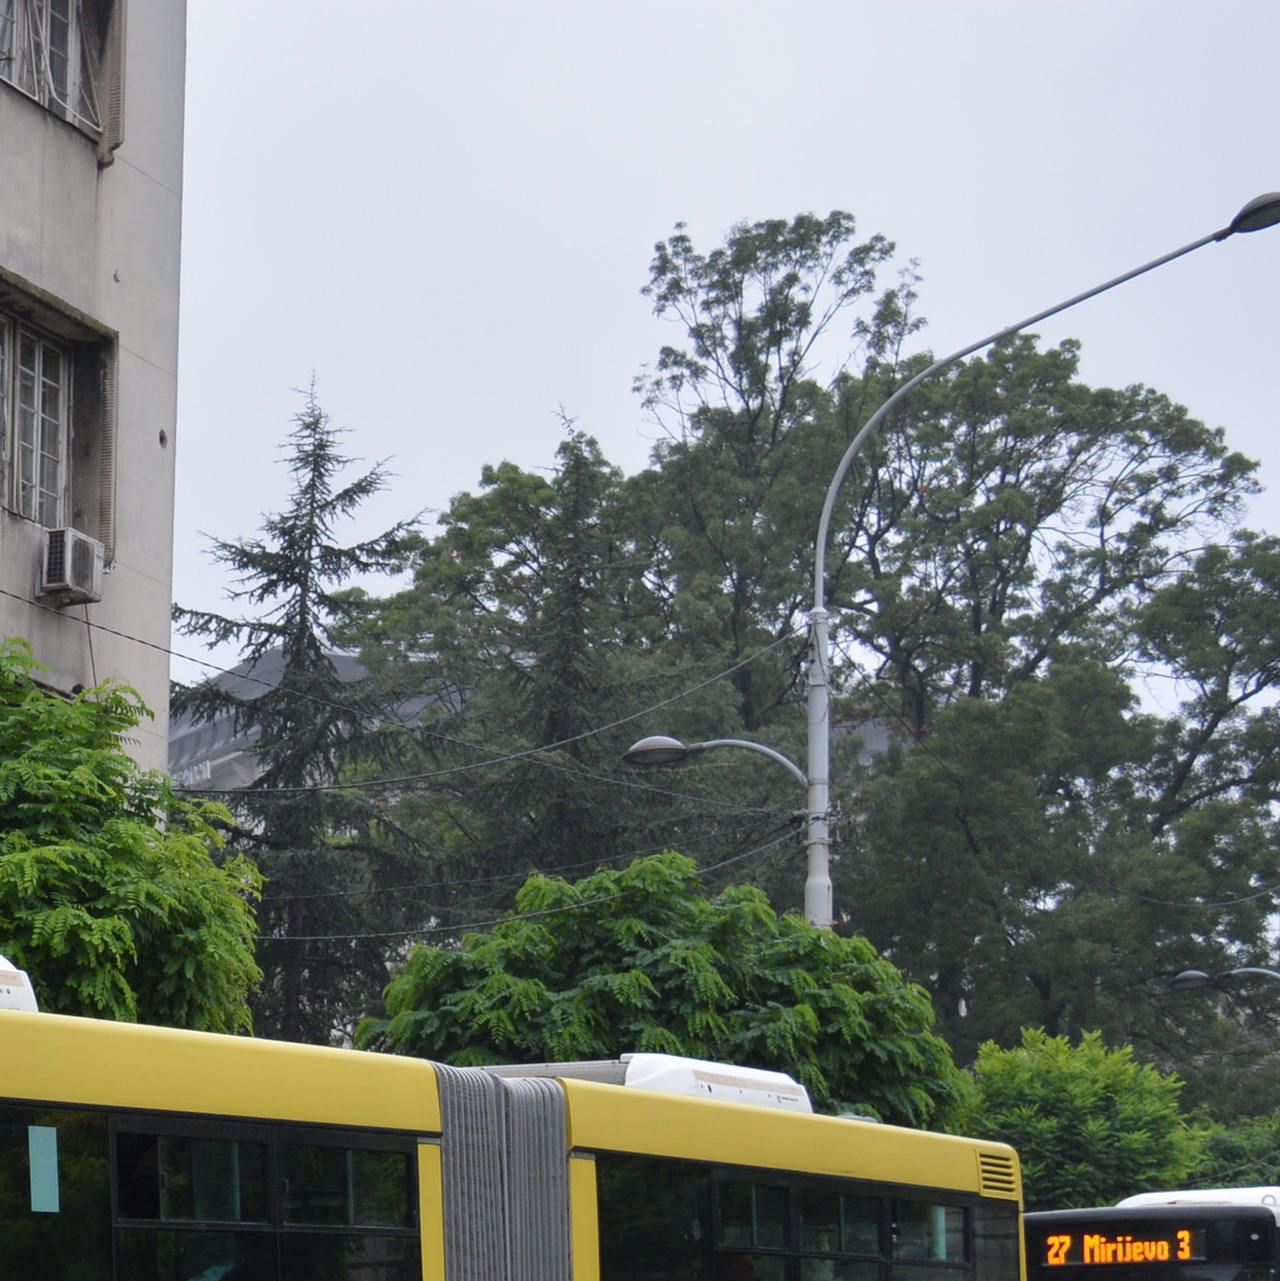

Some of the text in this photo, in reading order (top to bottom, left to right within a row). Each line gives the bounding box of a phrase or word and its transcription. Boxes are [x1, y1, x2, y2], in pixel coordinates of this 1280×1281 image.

[1046, 1230, 1190, 1265] 27 Mirijevo 3
